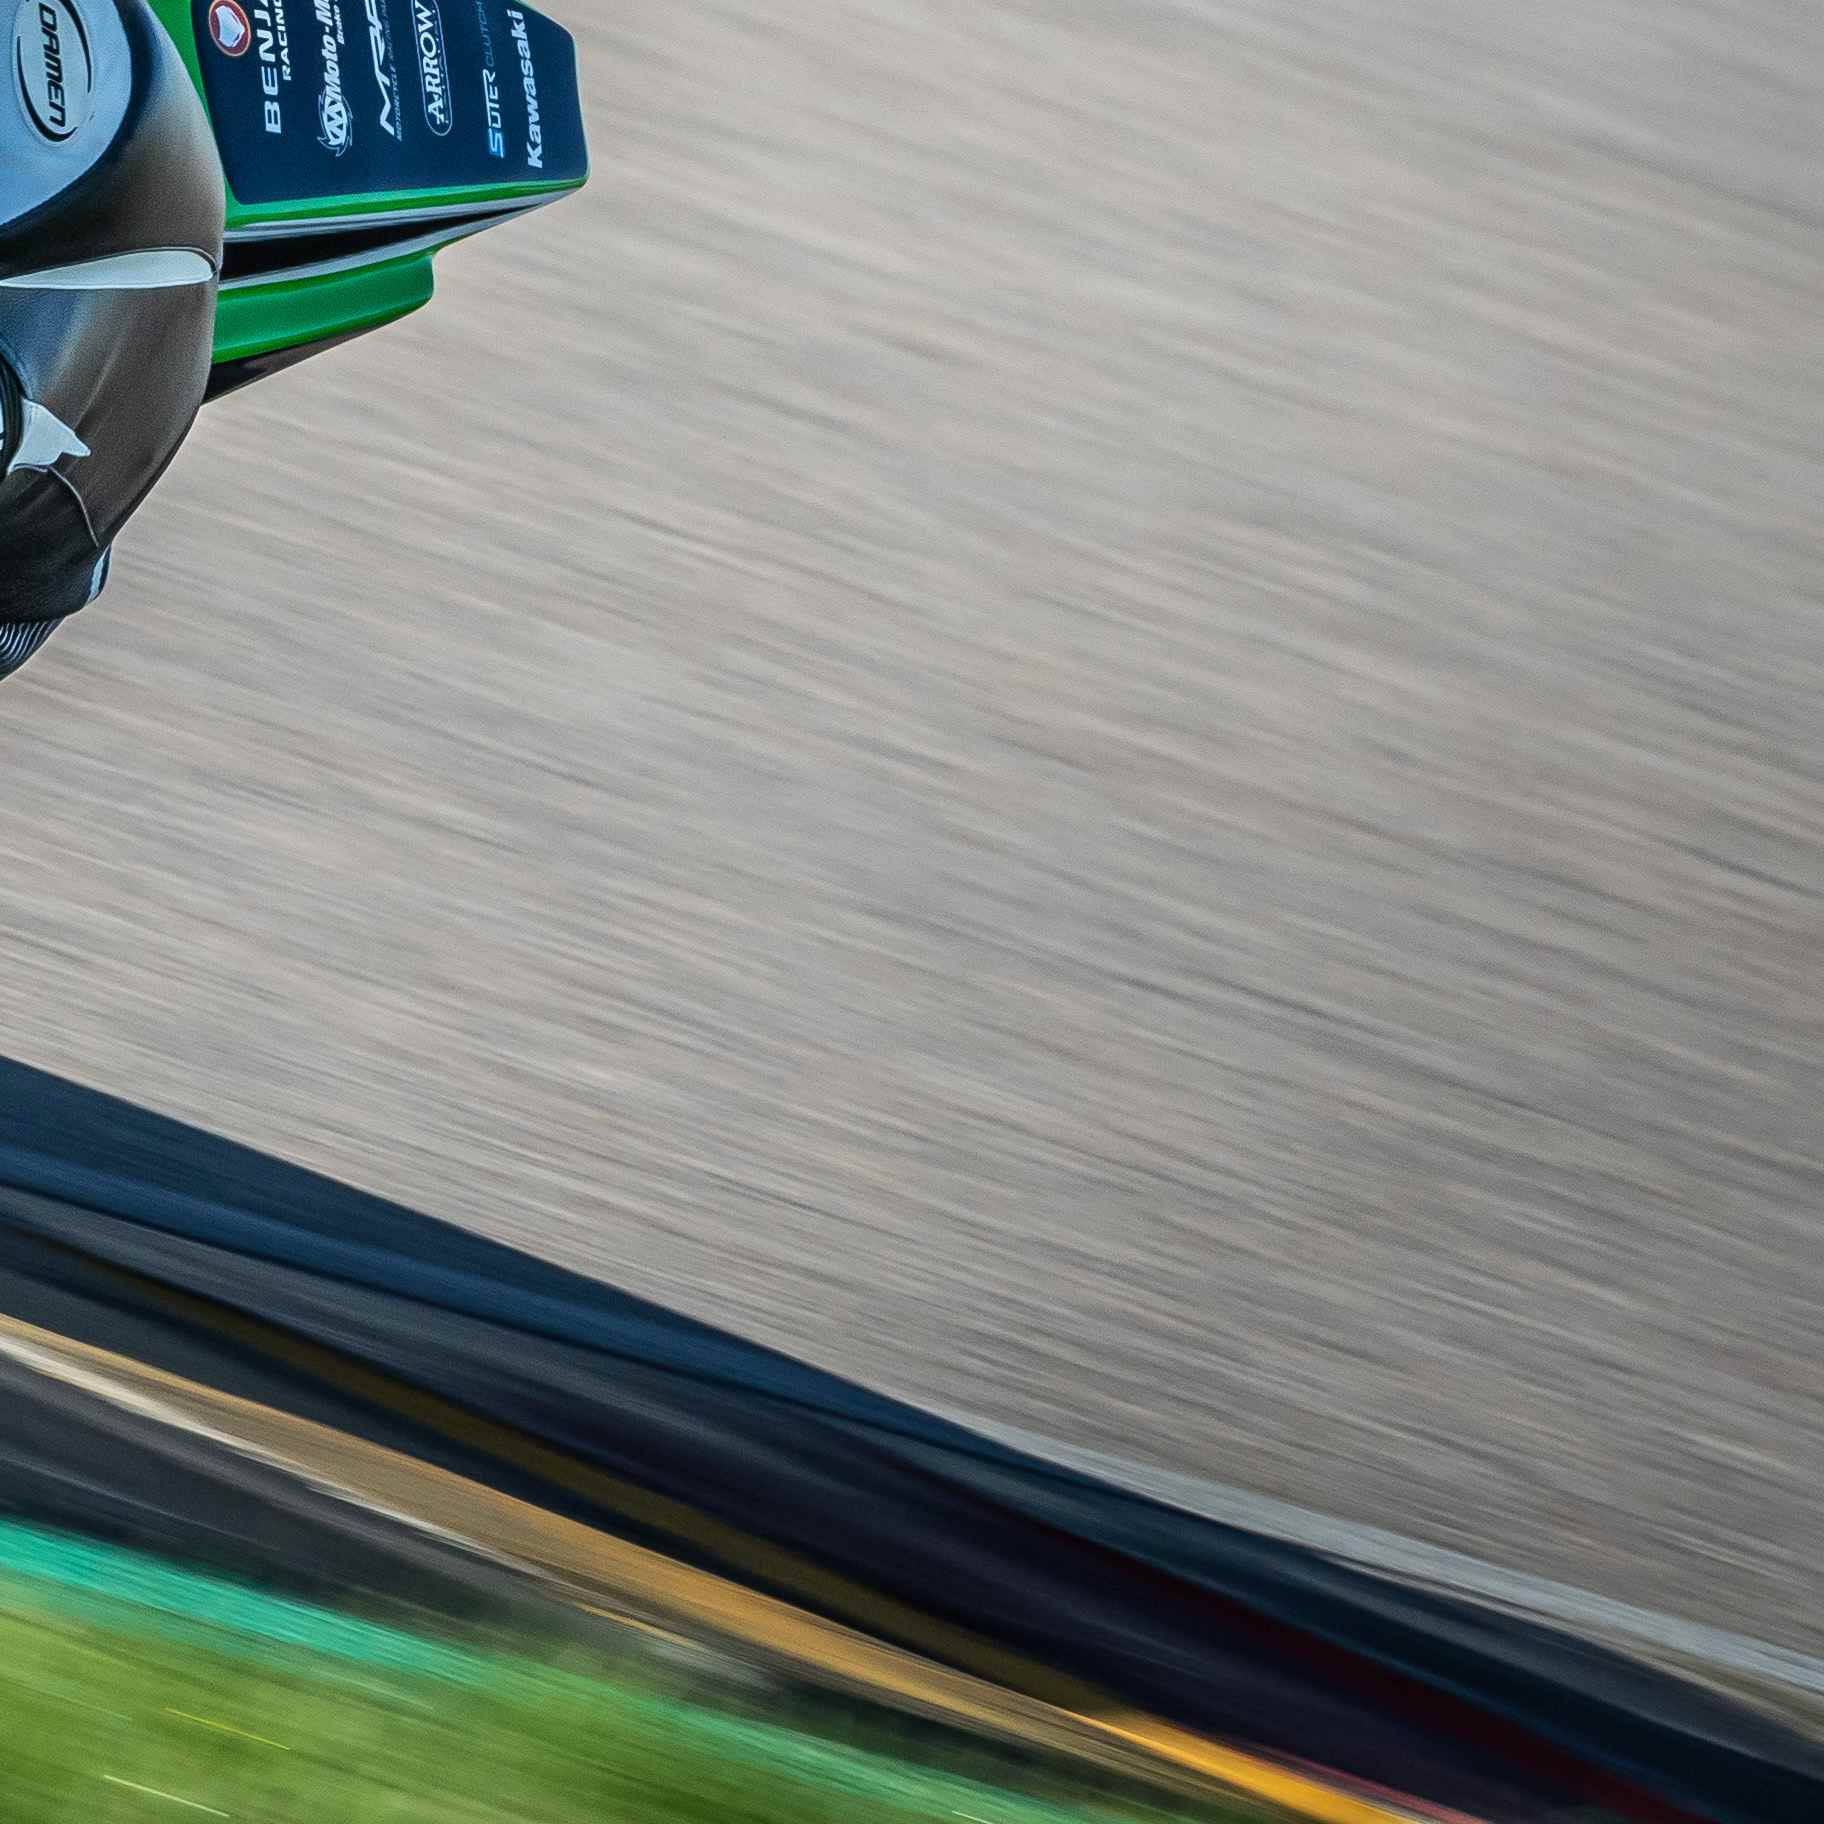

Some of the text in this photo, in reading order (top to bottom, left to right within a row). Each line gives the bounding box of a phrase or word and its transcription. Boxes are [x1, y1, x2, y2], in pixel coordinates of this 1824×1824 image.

[39, 4, 66, 127] DAMEN
[334, 4, 345, 45] Brake
[414, 0, 445, 126] ARROW
[474, 1, 495, 67] CLUTCH
[505, 10, 542, 168] Kawasaki
